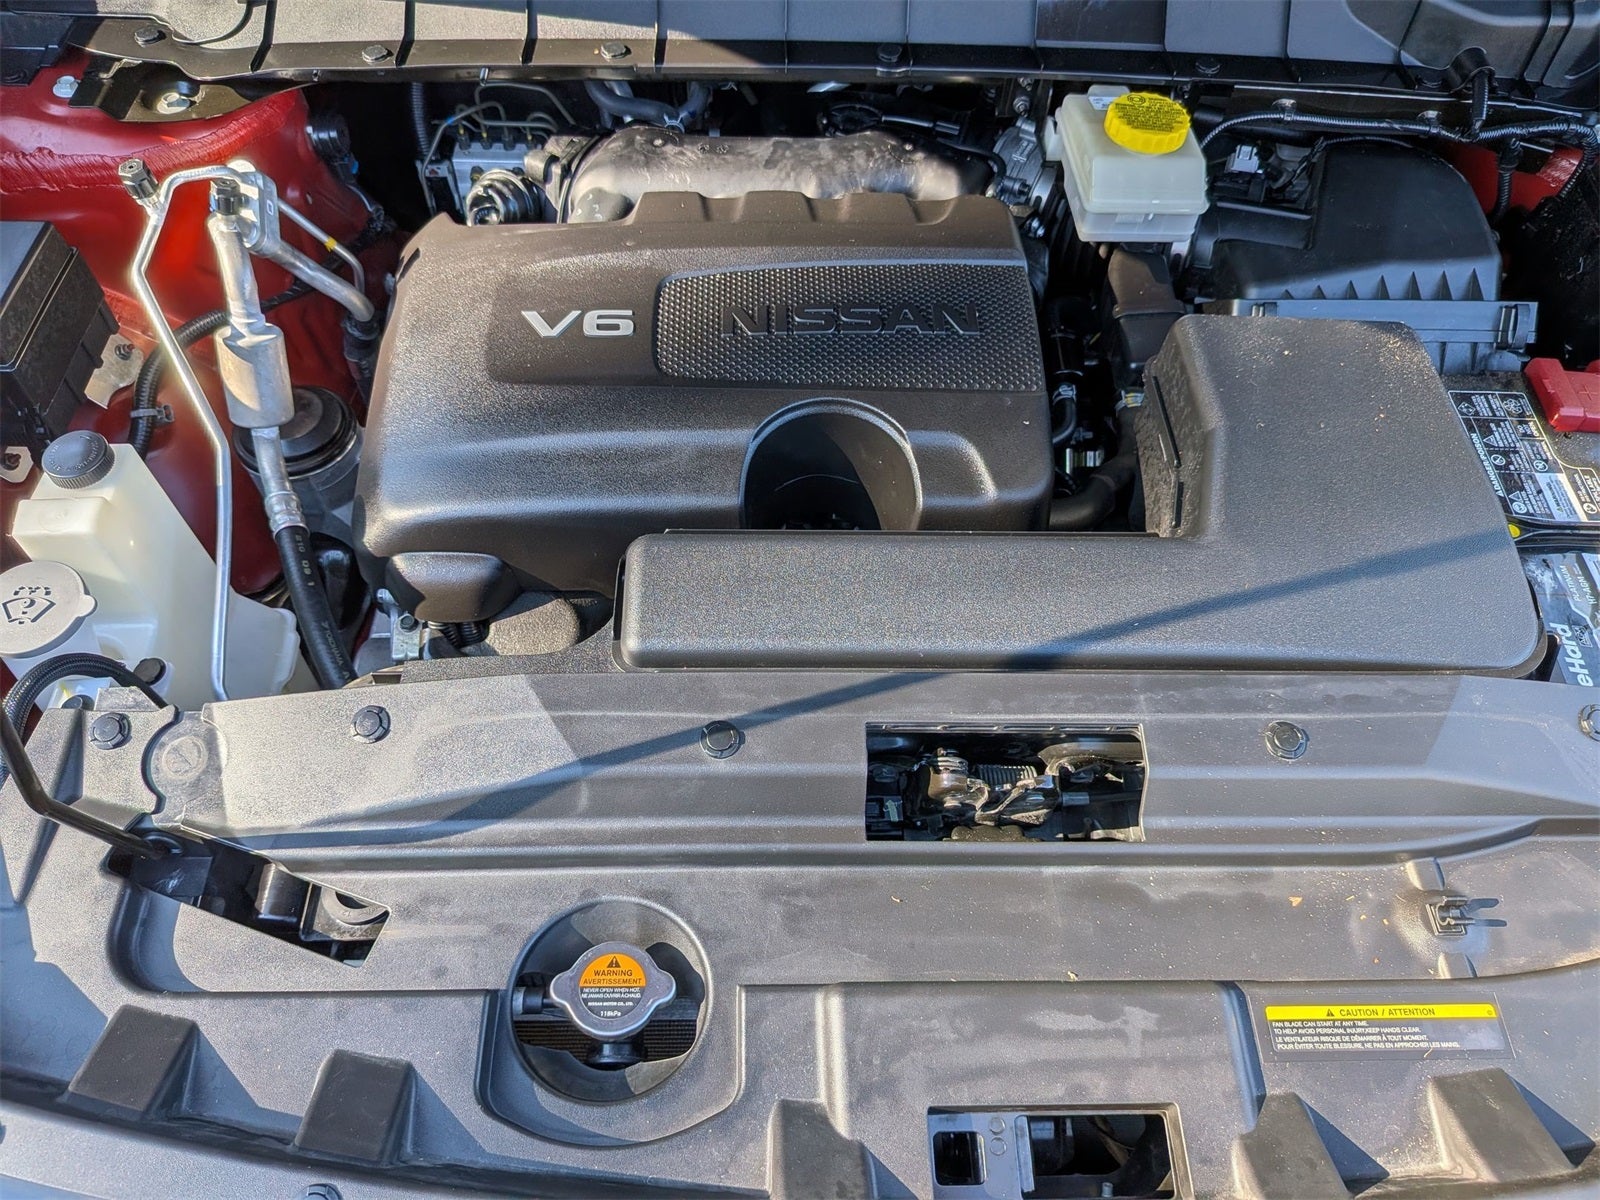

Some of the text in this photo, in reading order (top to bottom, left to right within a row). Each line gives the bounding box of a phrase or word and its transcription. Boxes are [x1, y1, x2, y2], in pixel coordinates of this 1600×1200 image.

[520, 309, 635, 338] V6
[720, 302, 979, 337] NISSAN
[593, 969, 633, 977] WARNING
[1339, 1008, 1379, 1017] CAUTION
[1388, 1008, 1436, 1016] ATTENTION
